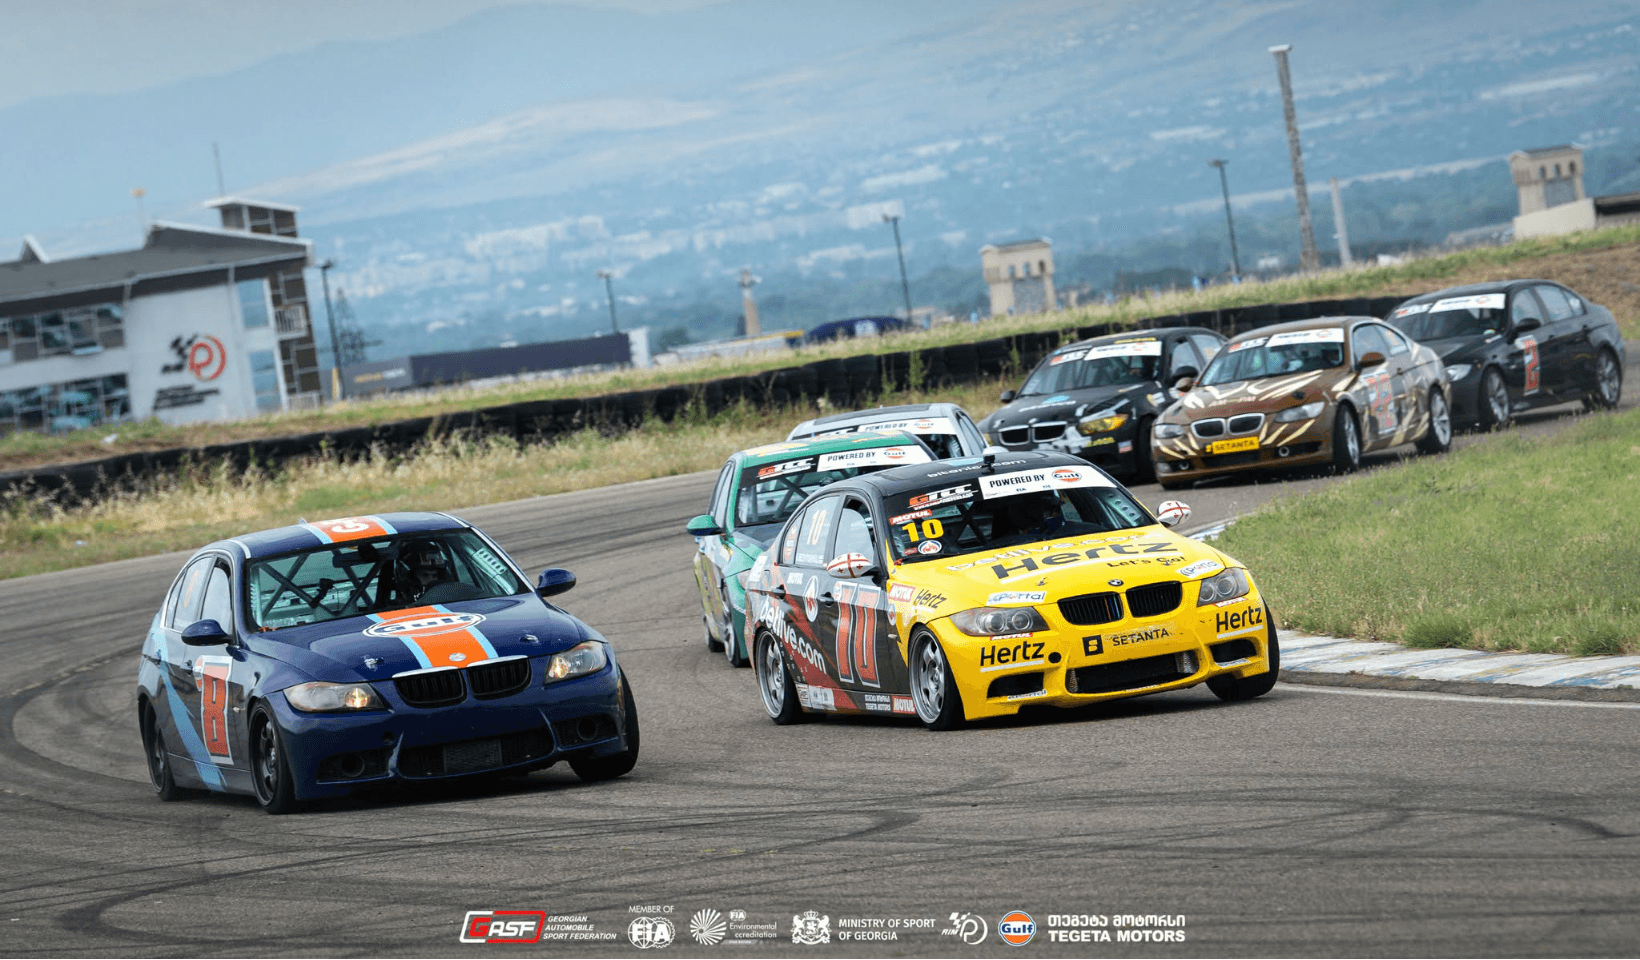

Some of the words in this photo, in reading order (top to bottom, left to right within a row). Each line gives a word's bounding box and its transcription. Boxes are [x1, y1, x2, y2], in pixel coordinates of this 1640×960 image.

[1215, 440, 1255, 451] SETANTA
[827, 453, 864, 462] POWERED
[989, 475, 1032, 488] POWERED
[806, 509, 827, 546] 10
[892, 510, 931, 524] MOTUL
[902, 518, 944, 542] 10
[991, 542, 1177, 579] Hertz
[1106, 558, 1151, 568] Let's
[1155, 555, 1186, 567] Go!
[891, 584, 915, 601] MOTUL
[913, 588, 947, 609] Hertz
[373, 613, 473, 634] Gulf
[1216, 605, 1263, 633] Hertz
[835, 581, 881, 689] 10
[1112, 628, 1169, 646] SETANTA
[980, 641, 1045, 666] Hertz
[203, 660, 231, 757] 8
[893, 697, 916, 712] MOTUL
